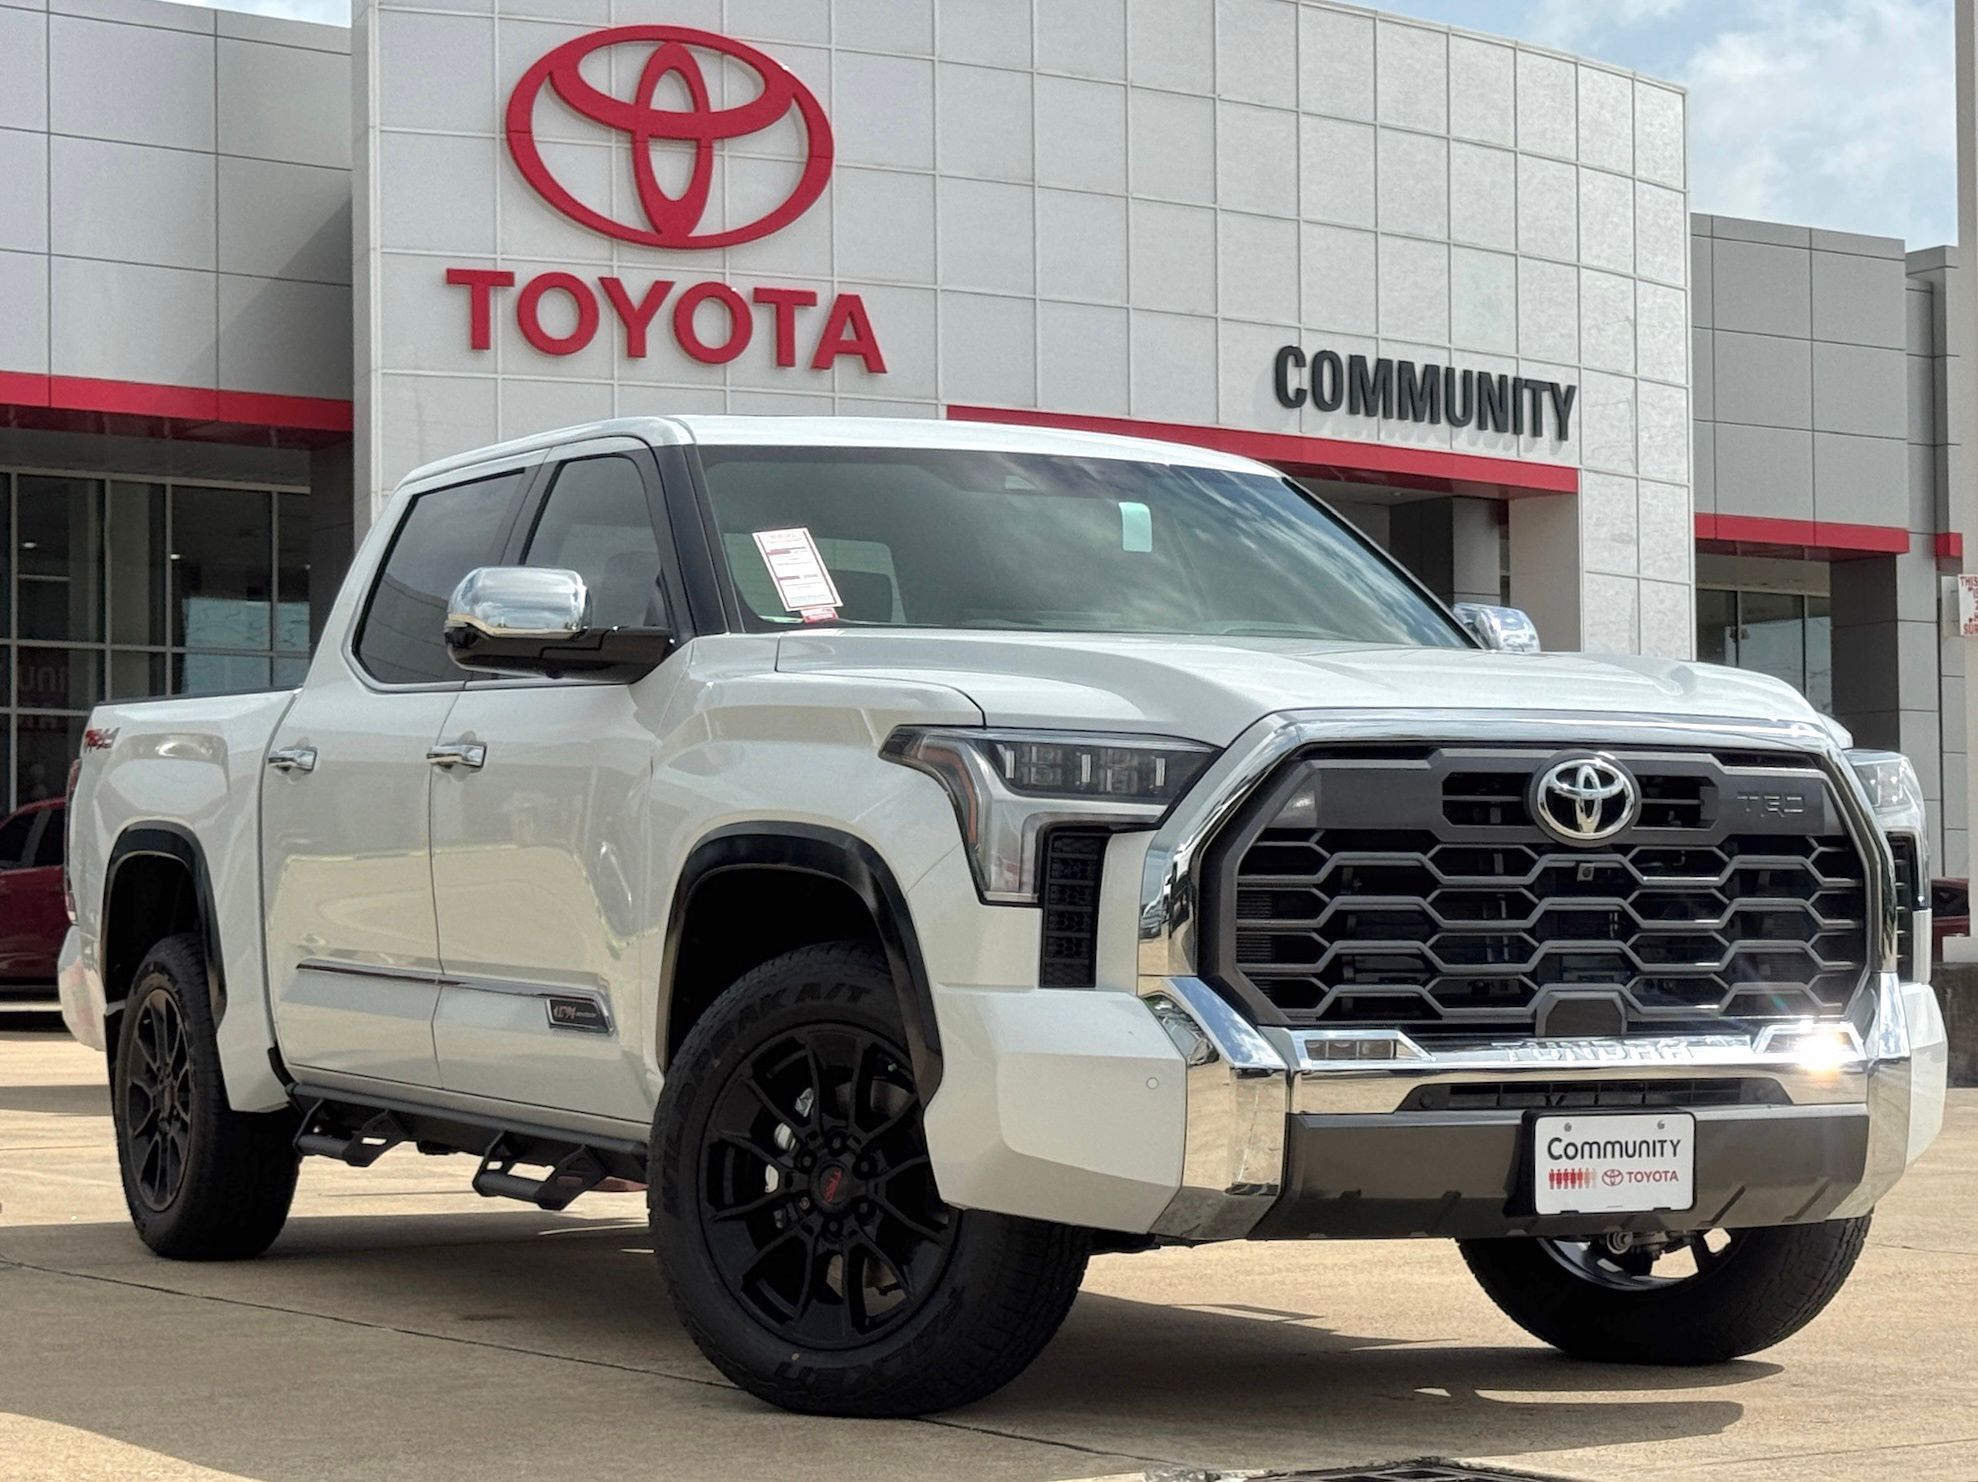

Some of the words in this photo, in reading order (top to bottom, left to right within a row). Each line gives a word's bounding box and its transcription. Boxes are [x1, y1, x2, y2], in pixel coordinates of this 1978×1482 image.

[446, 268, 888, 374] TOYOTA
[1275, 345, 1577, 441] COMMUNITY
[1736, 792, 1806, 817] TRD
[794, 981, 872, 1003] A/T
[1490, 1038, 1694, 1062] TUNDRA
[1626, 1170, 1680, 1183] TOYOTA
